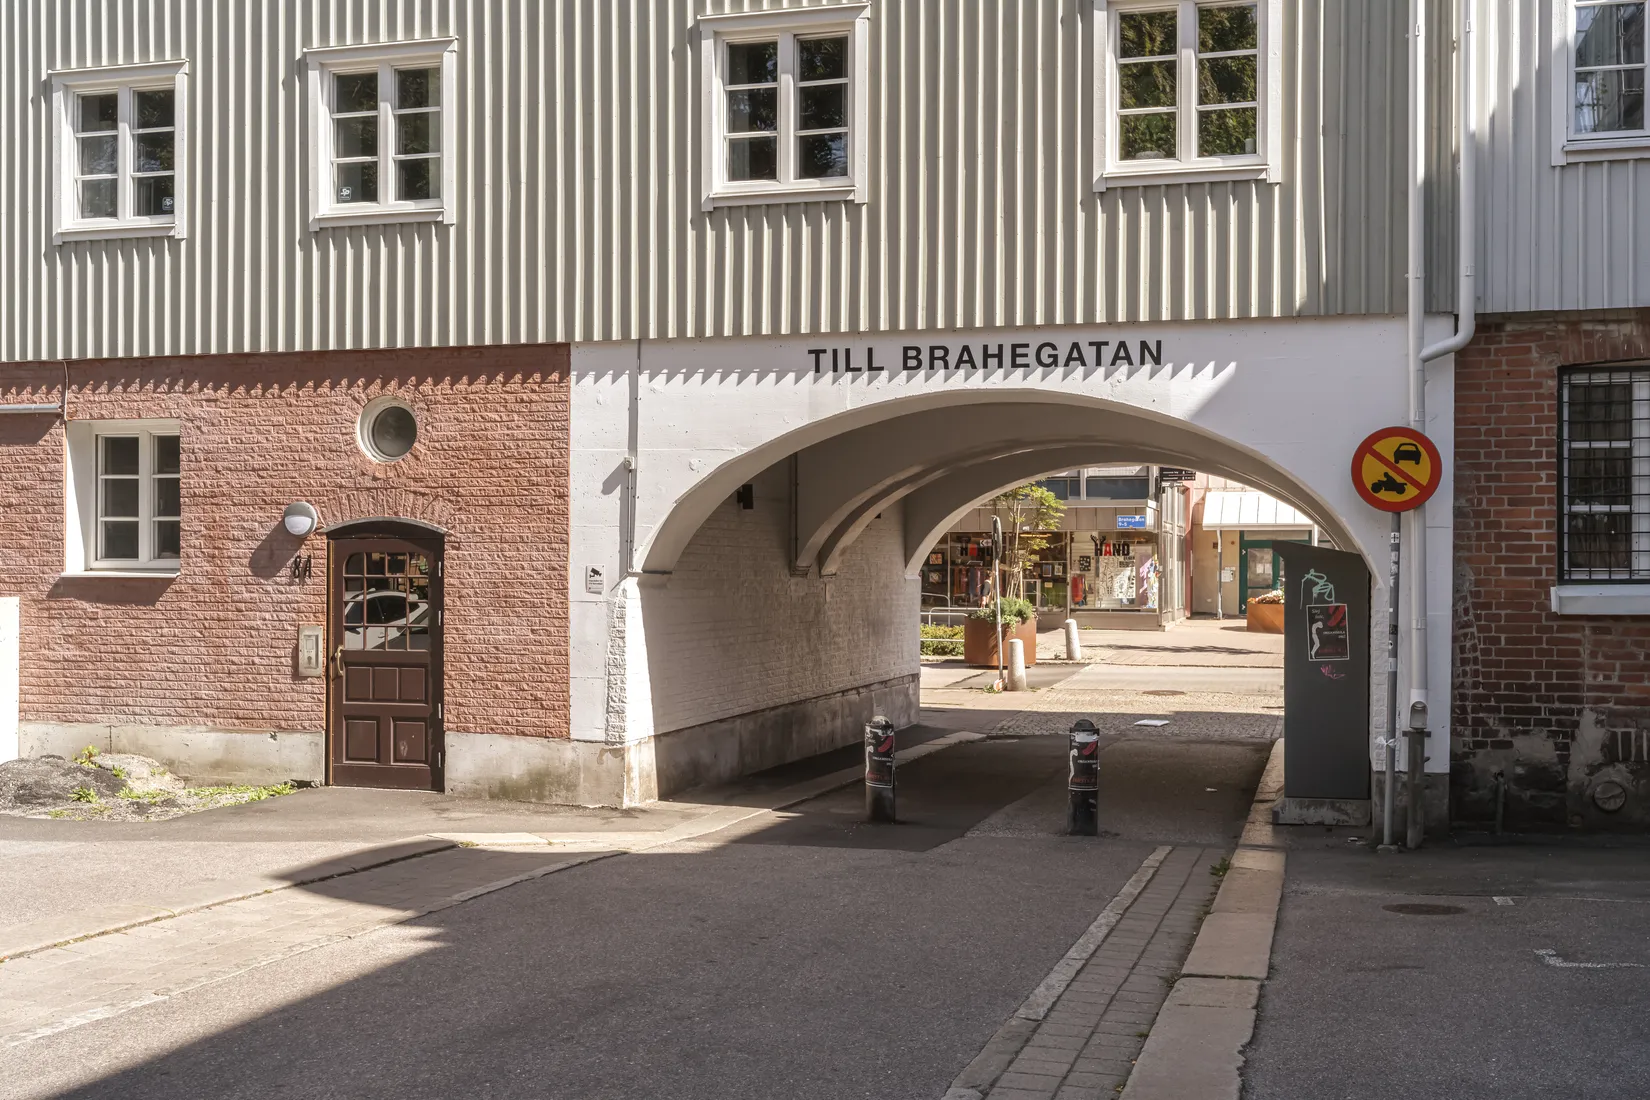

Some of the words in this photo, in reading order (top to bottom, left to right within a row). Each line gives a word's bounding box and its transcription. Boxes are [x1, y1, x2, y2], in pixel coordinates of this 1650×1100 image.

[808, 347, 885, 373] TILL
[902, 340, 1163, 371] BRAHEGATAN
[1091, 536, 1130, 556] HAND
[293, 554, 312, 580] 8A
